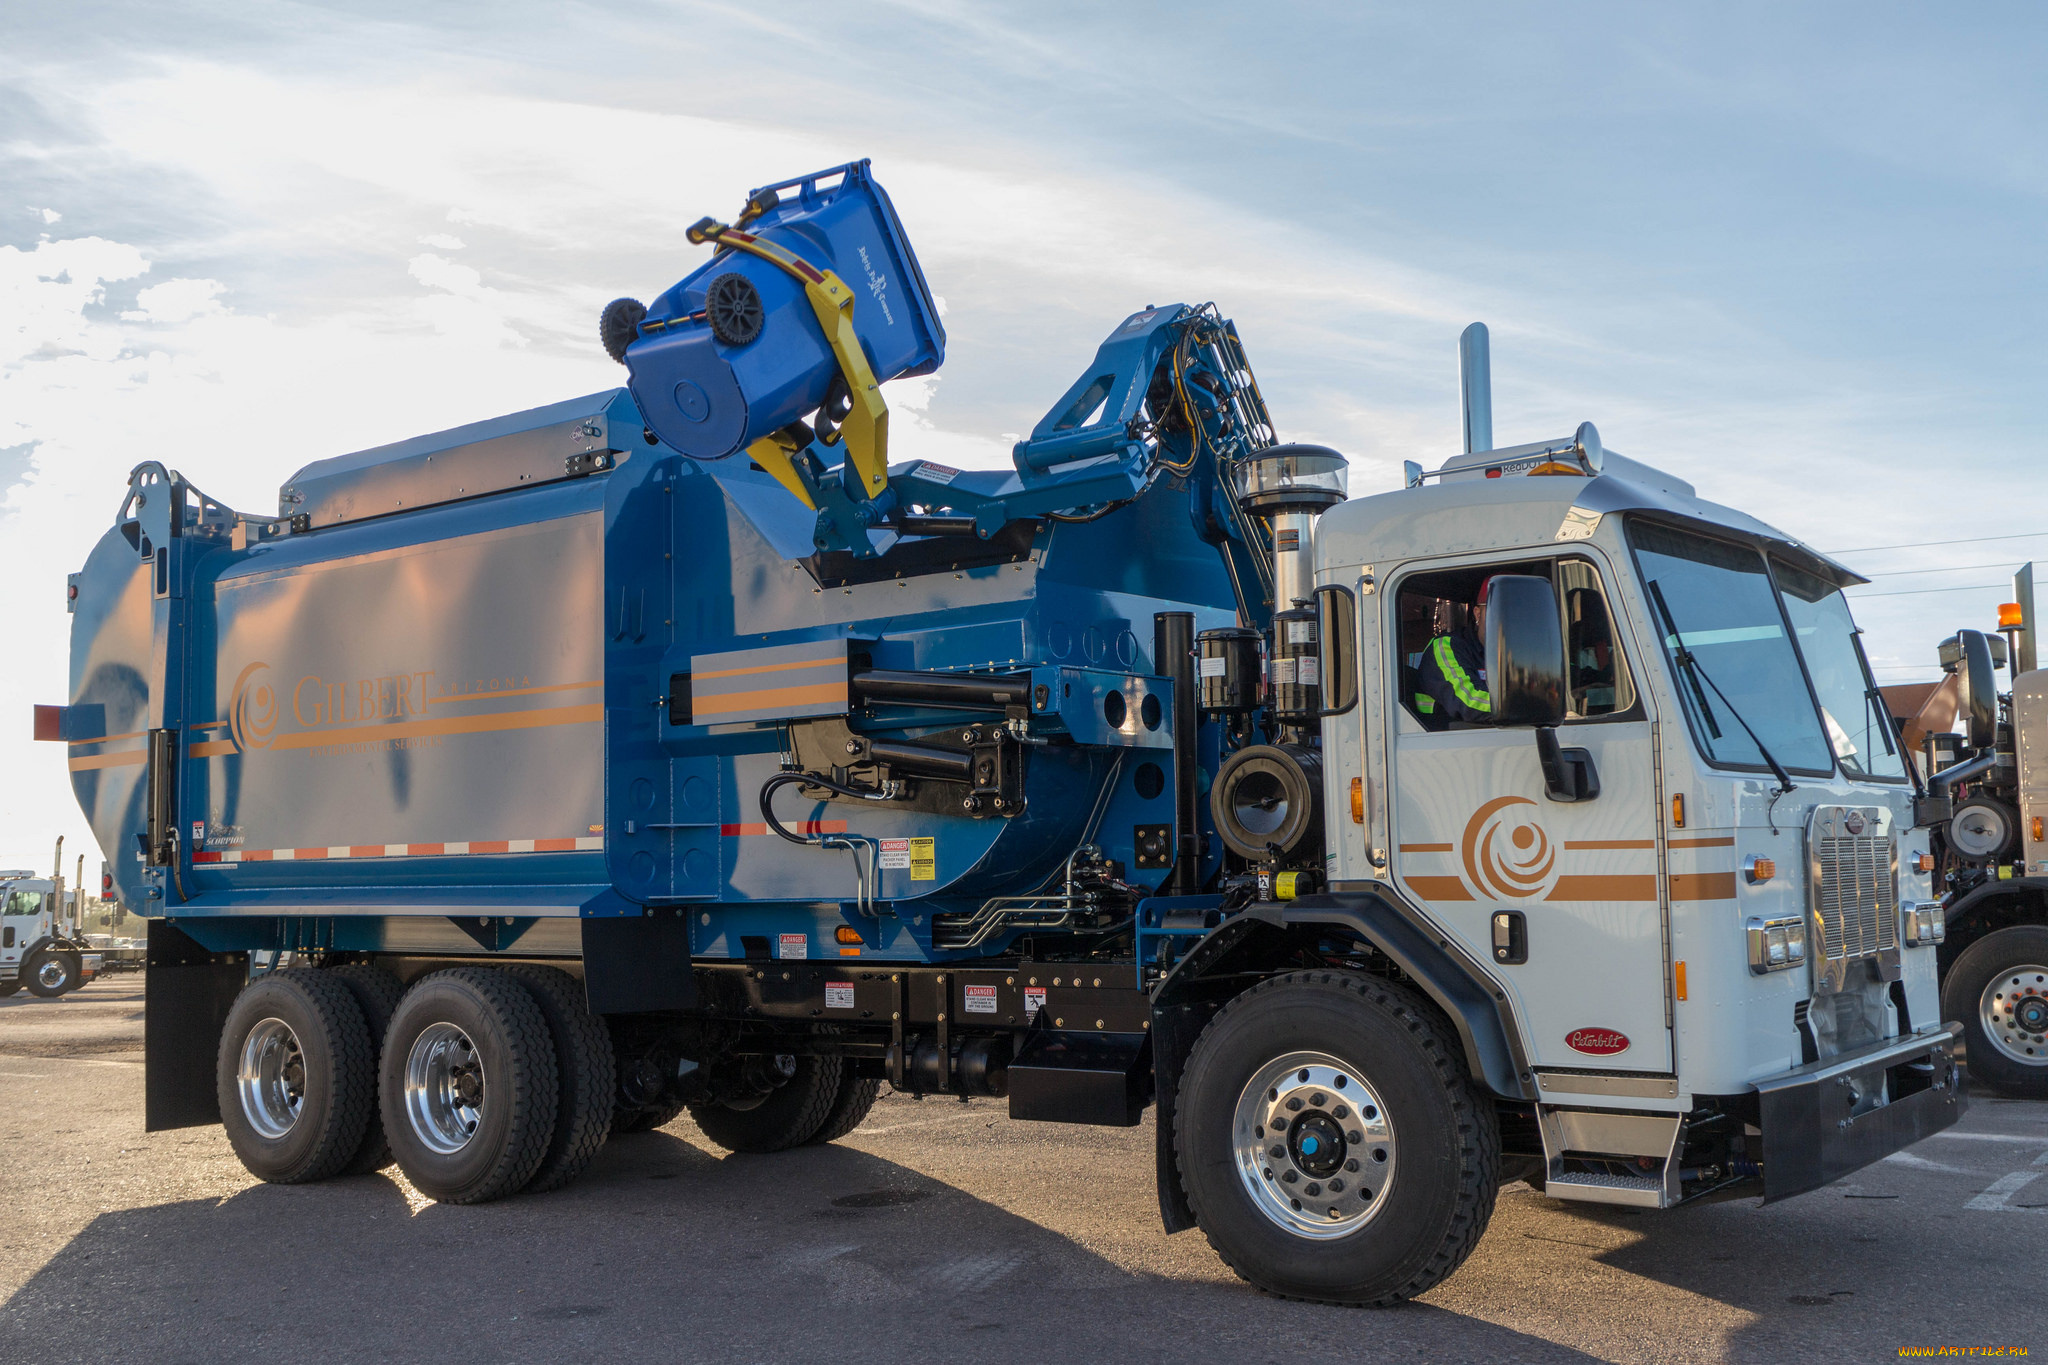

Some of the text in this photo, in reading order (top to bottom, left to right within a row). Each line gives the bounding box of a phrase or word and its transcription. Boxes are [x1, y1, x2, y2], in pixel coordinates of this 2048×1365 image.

[879, 293, 894, 326] Company
[438, 675, 530, 697] ARIZONA
[293, 669, 435, 727] GILBERT
[310, 735, 442, 758] ENVIRONMENTAL SERVICES
[206, 837, 244, 846] SCORPION
[1572, 1031, 1624, 1048] Peterbilt
